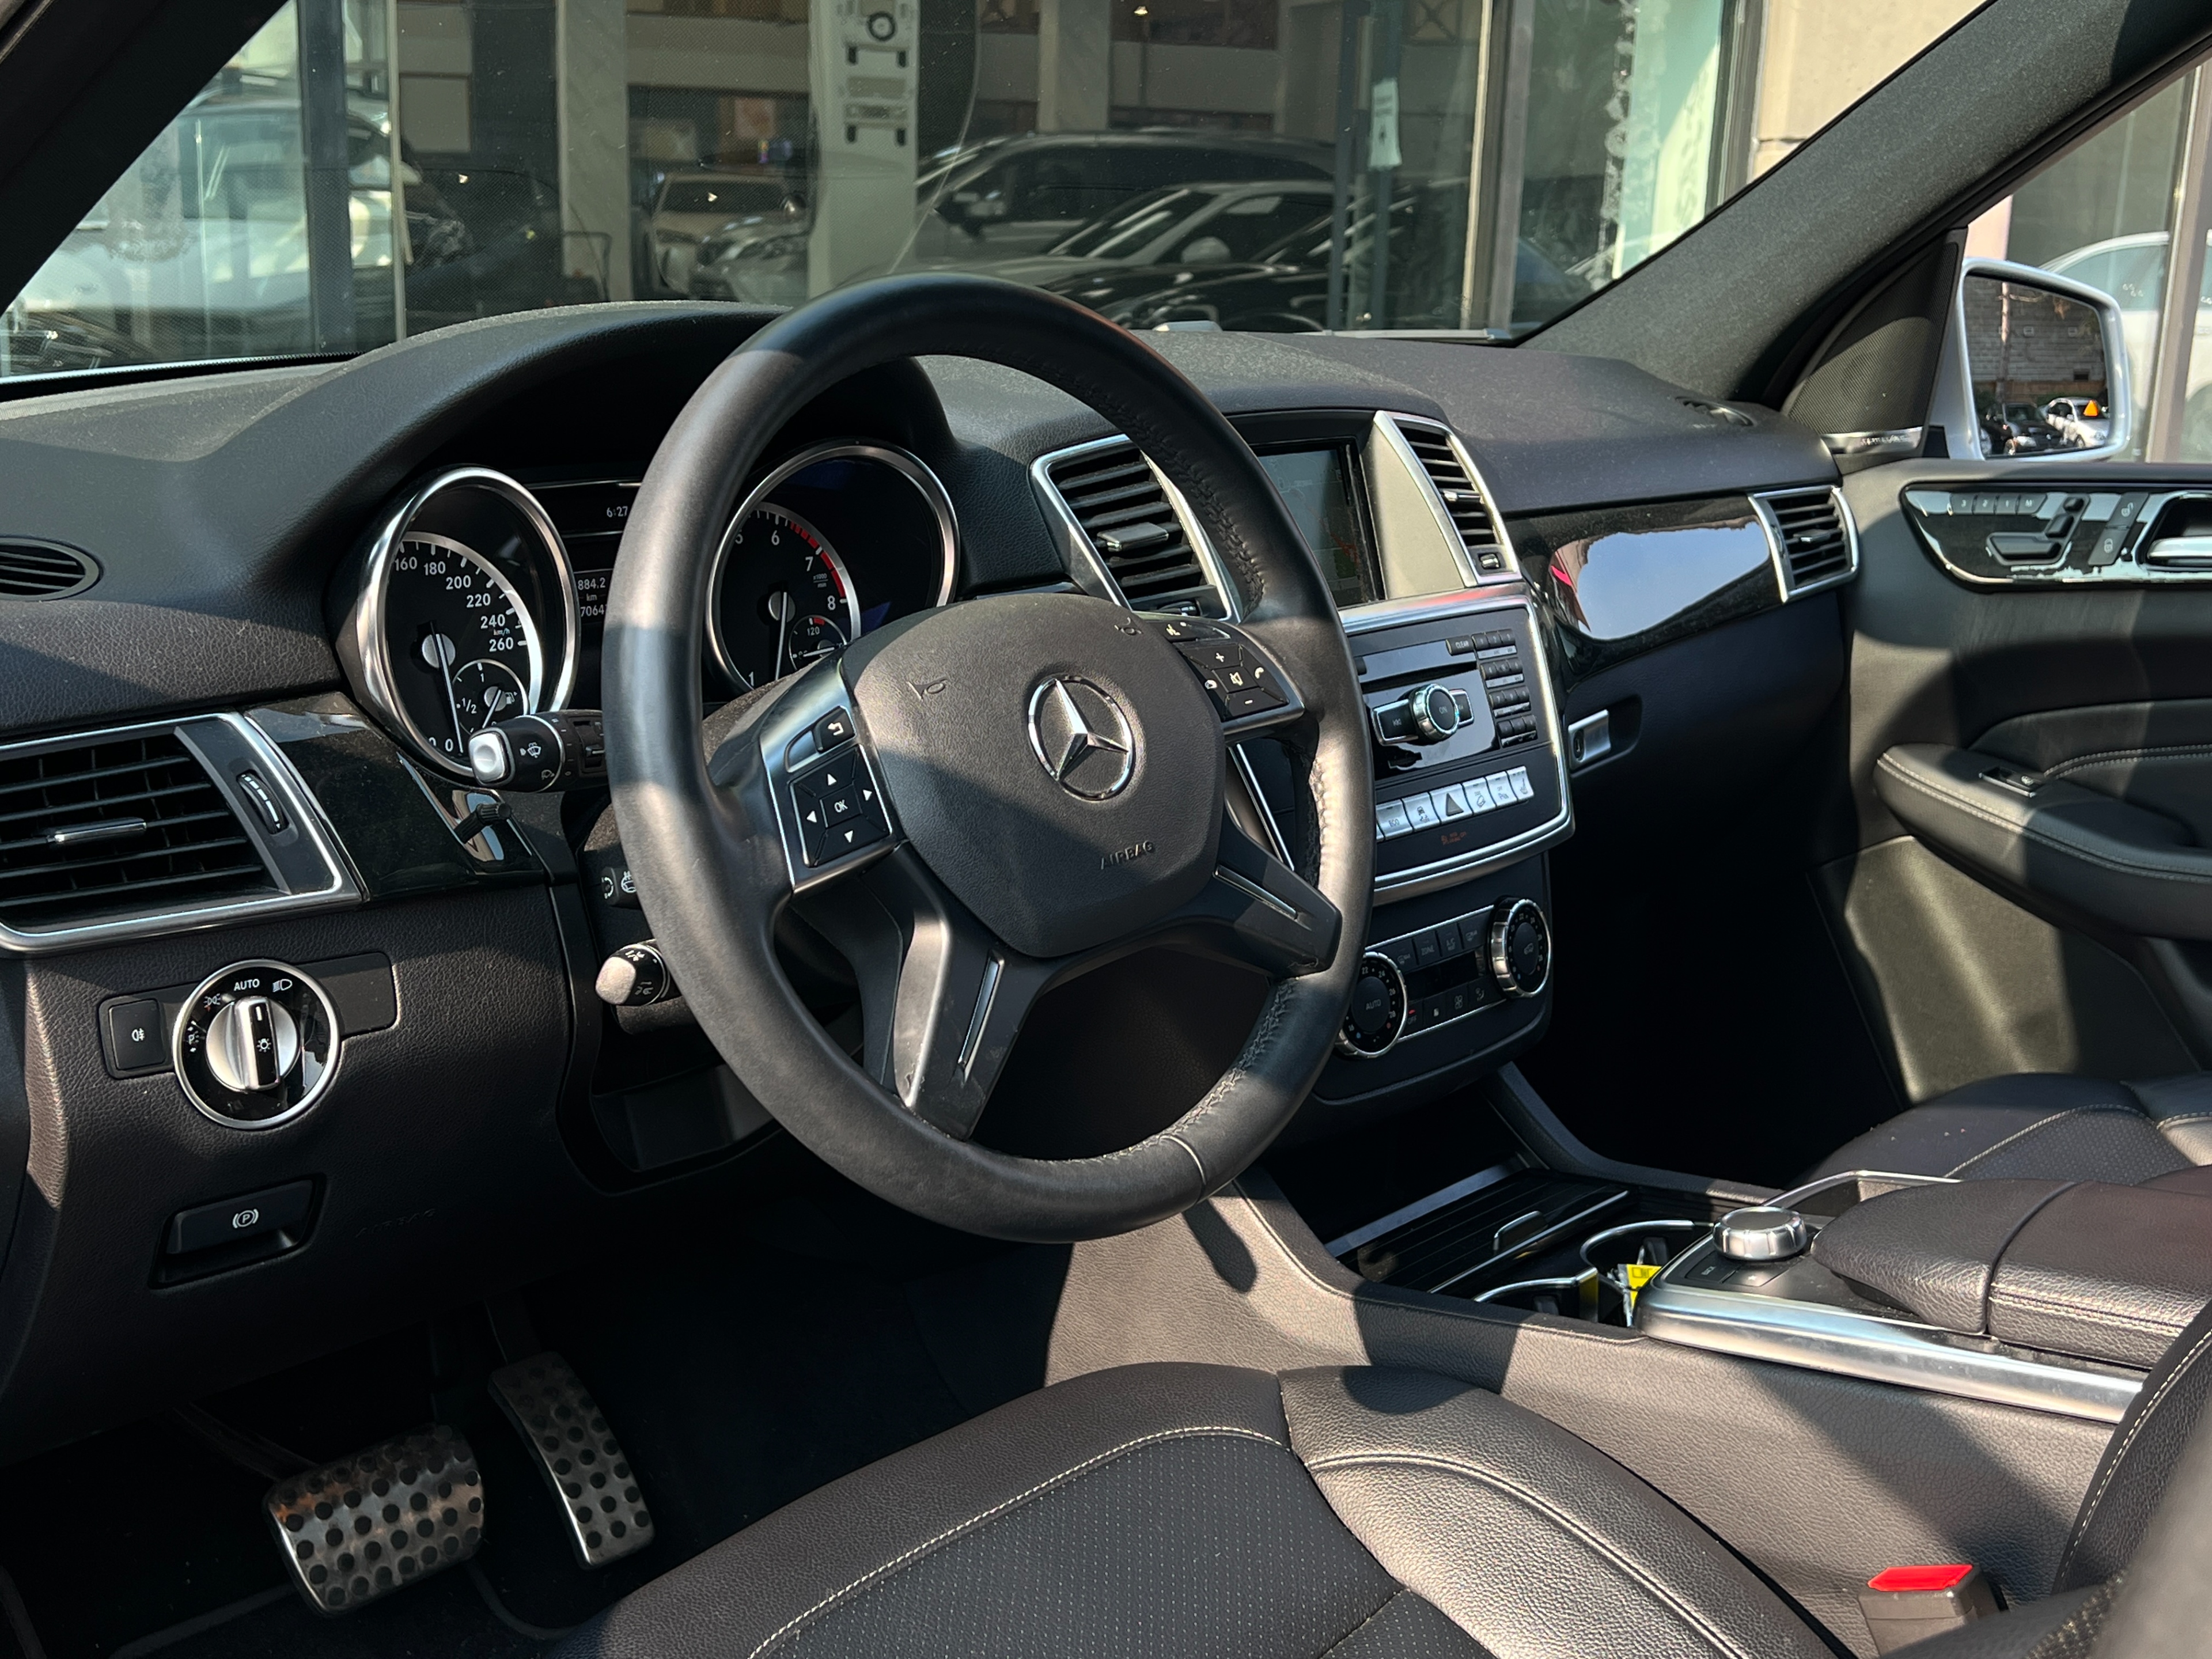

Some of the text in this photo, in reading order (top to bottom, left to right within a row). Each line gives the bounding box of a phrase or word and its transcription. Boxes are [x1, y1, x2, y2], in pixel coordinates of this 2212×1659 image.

[607, 506, 628, 517] 6:27
[771, 530, 780, 546] 6
[395, 556, 418, 571] 160
[423, 561, 446, 575] 180
[805, 556, 813, 571] 7
[446, 575, 471, 590] 200
[578, 577, 606, 590] 884.2
[467, 593, 490, 608] 220
[586, 593, 597, 601] km
[827, 595, 836, 611] 8
[480, 614, 505, 629] 240
[807, 626, 820, 636] 120
[490, 637, 514, 652] 260
[480, 673, 484, 682] 1
[461, 698, 477, 714] 1/2
[445, 738, 453, 752] 0
[834, 800, 849, 813] OK
[1100, 839, 1154, 870] AIRBAG
[233, 978, 260, 991] AUTO
[1366, 999, 1382, 1010] AUTO
